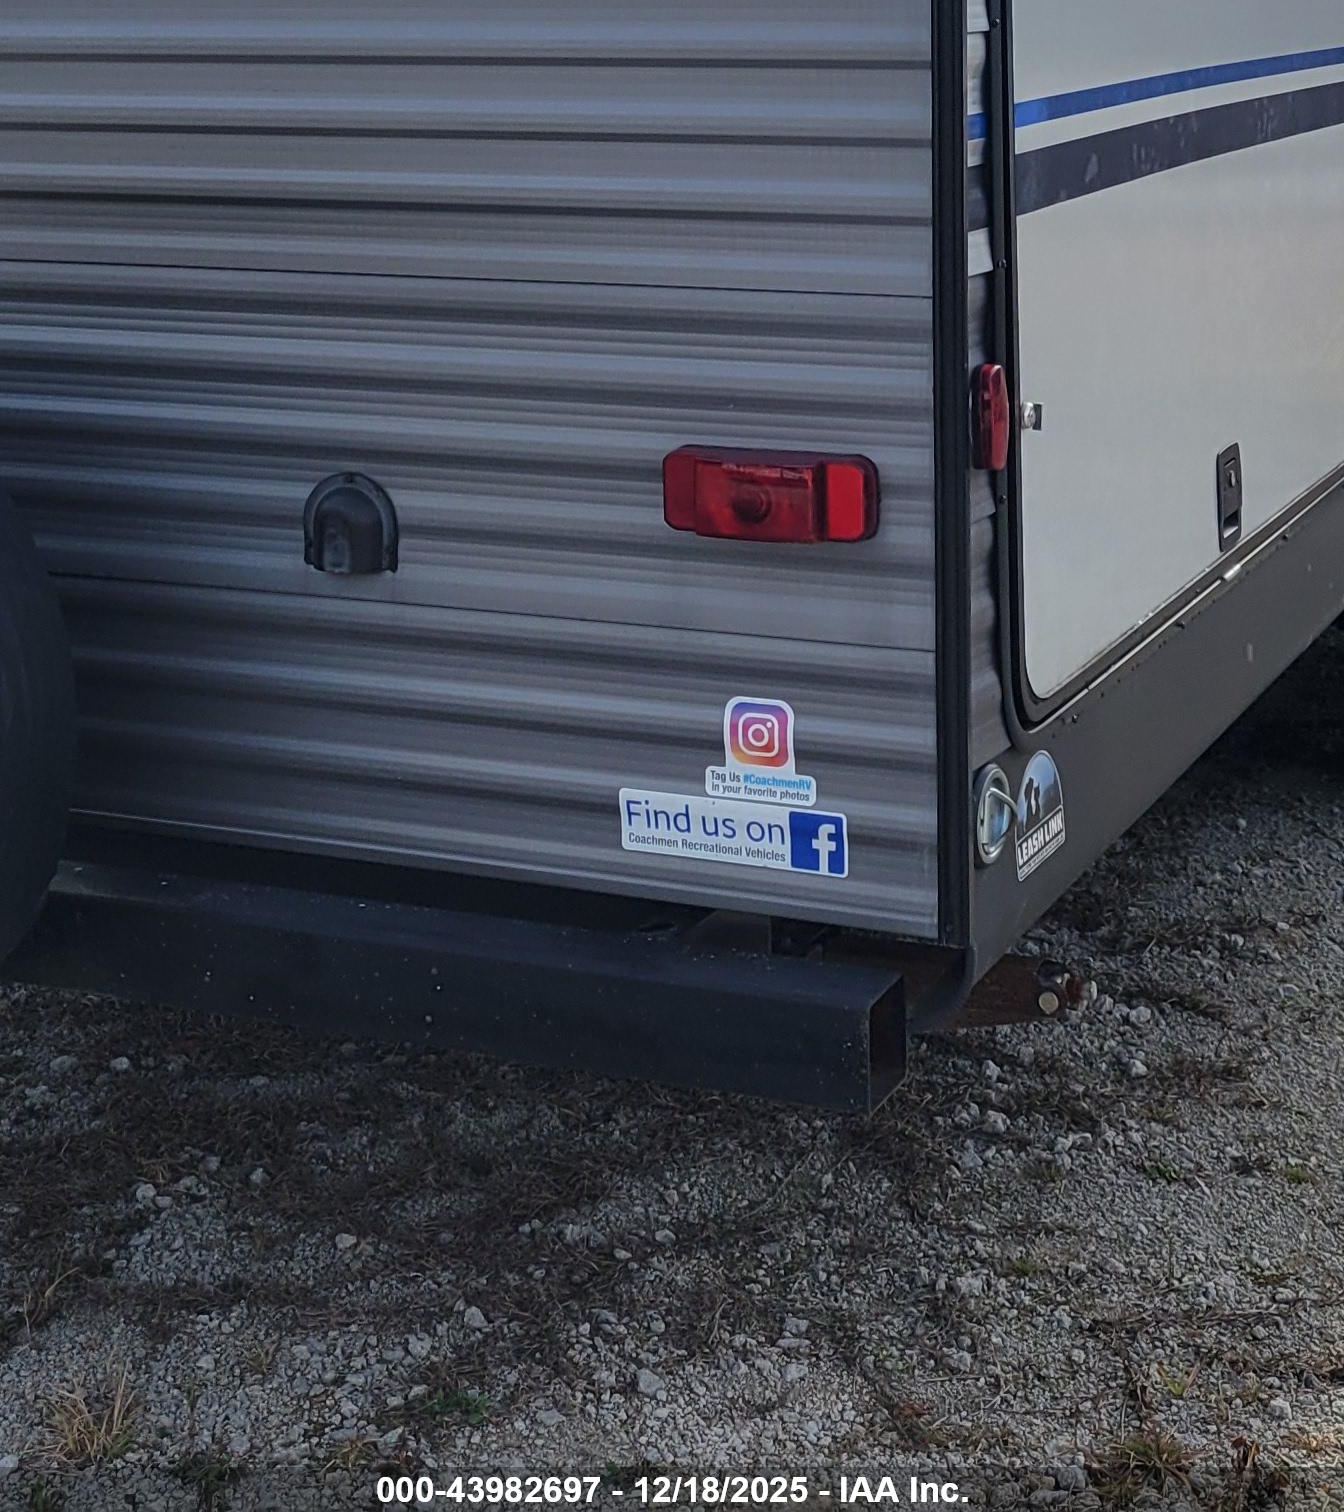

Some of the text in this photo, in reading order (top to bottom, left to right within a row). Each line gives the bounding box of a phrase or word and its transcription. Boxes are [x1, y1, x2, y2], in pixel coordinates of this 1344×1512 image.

[710, 770, 811, 790] Tag Us #CoachmenRV
[721, 783, 742, 794] your
[744, 785, 777, 798] favorite
[780, 790, 810, 801] photos
[625, 799, 692, 833] Find
[701, 815, 737, 838] us
[746, 820, 785, 845] on
[628, 832, 786, 862] Coachmen Recreational Vehicles
[1018, 827, 1044, 867] LEASH
[1044, 810, 1063, 843] LINK
